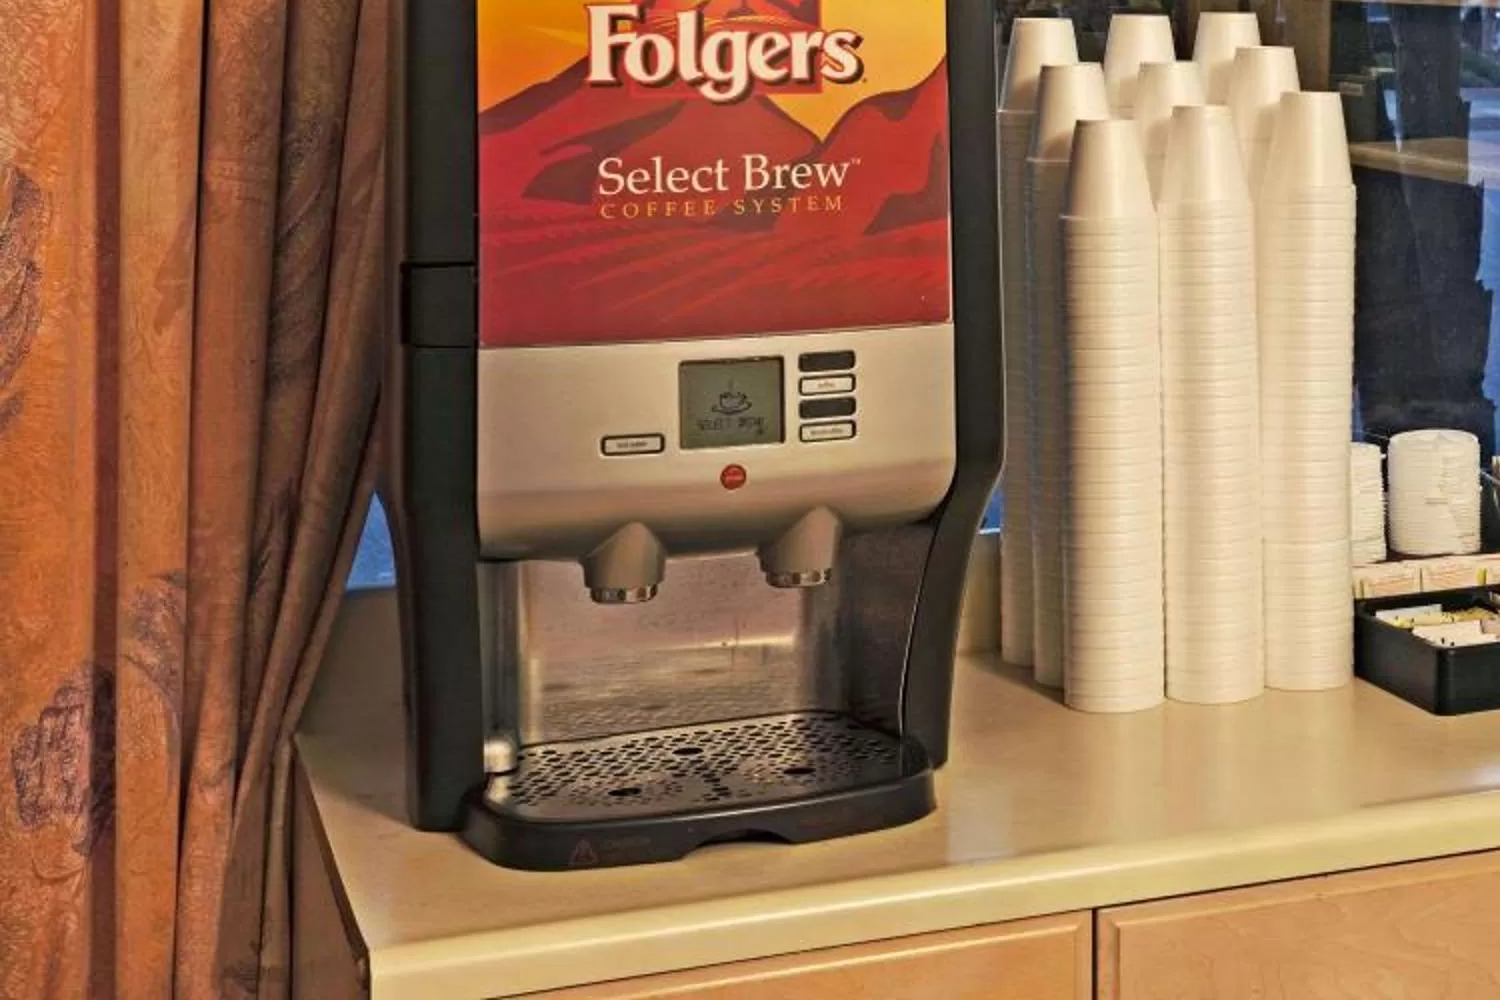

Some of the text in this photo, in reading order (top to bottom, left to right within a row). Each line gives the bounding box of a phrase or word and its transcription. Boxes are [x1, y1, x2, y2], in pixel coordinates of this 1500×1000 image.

[584, 3, 866, 104] Folgers
[598, 156, 729, 195] Select
[743, 153, 851, 192] Brew
[601, 195, 843, 219] COFFEE SYSTEM
